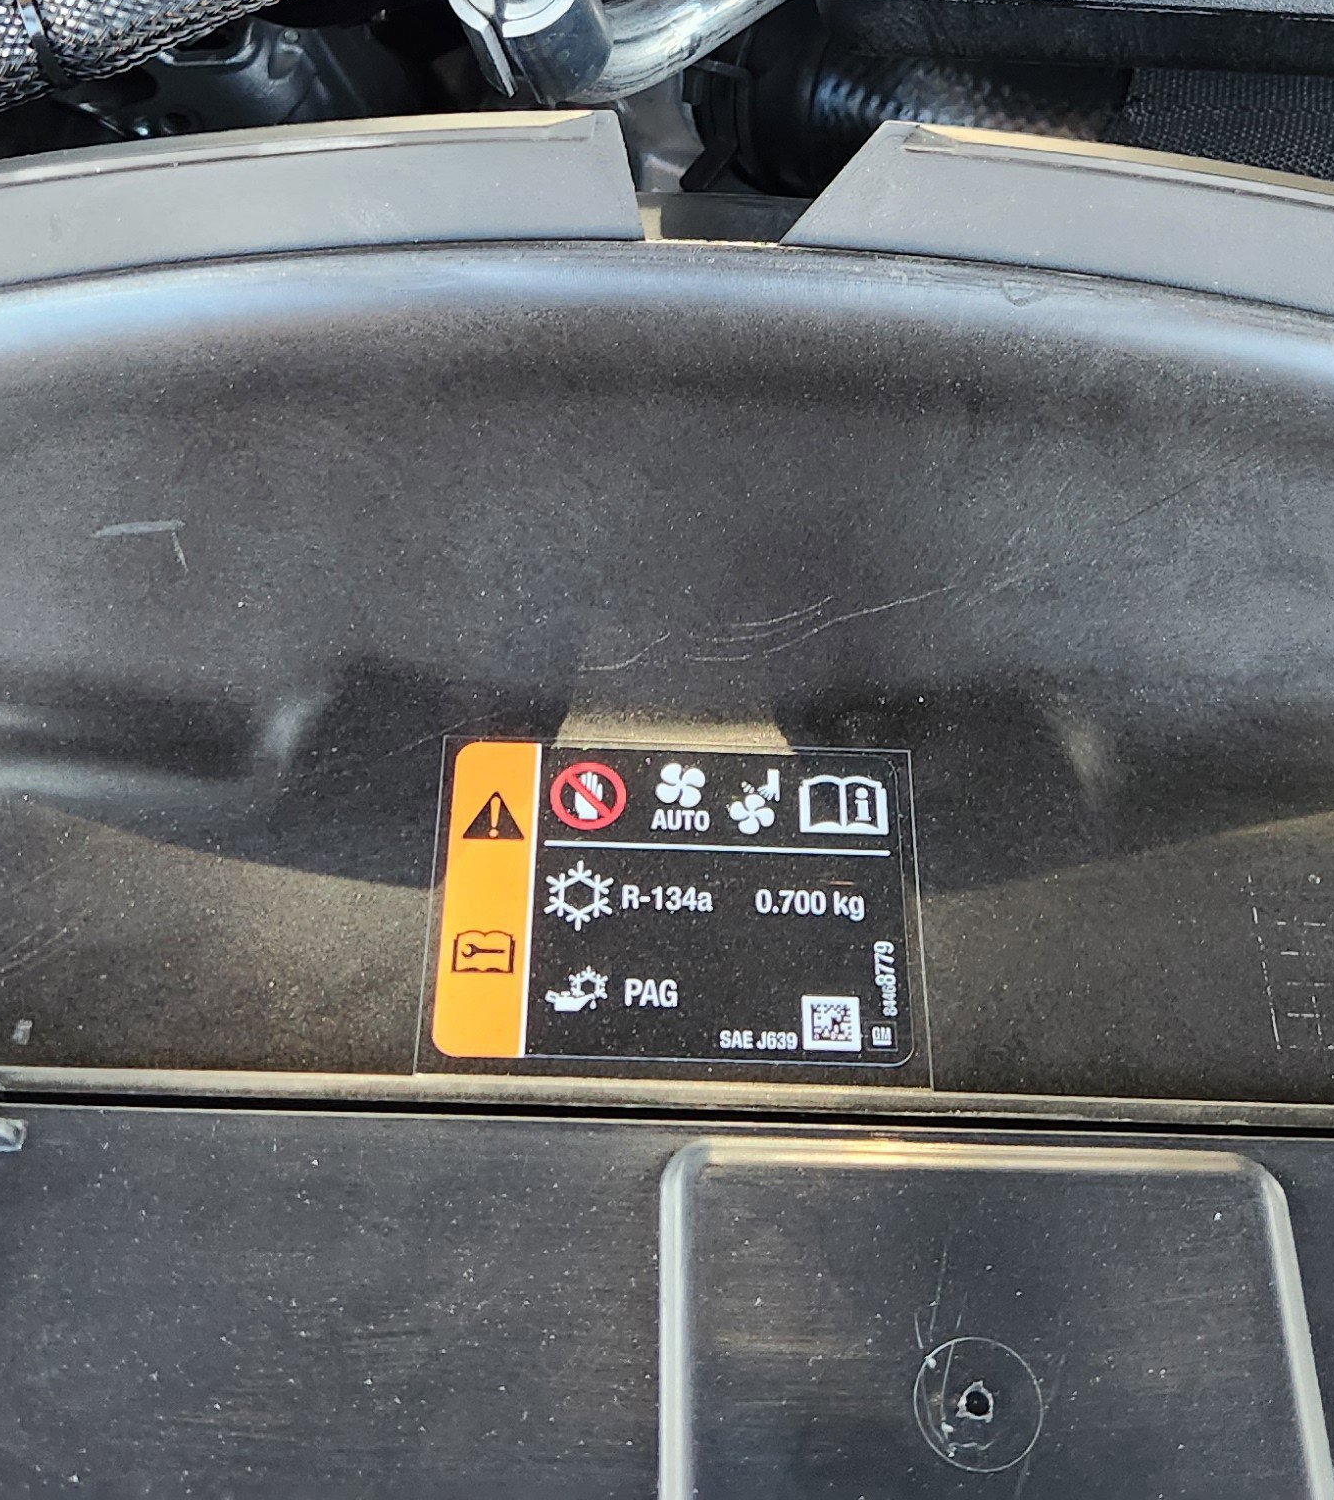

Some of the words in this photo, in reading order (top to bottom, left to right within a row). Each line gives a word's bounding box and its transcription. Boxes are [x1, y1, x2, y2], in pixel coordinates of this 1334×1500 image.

[651, 809, 710, 832] AUTO
[621, 884, 714, 913] R-134a
[755, 888, 827, 915] 0.700
[833, 890, 866, 922] kg
[624, 978, 679, 1008] PAG
[719, 1030, 754, 1049] SAE
[756, 1031, 798, 1050] J639
